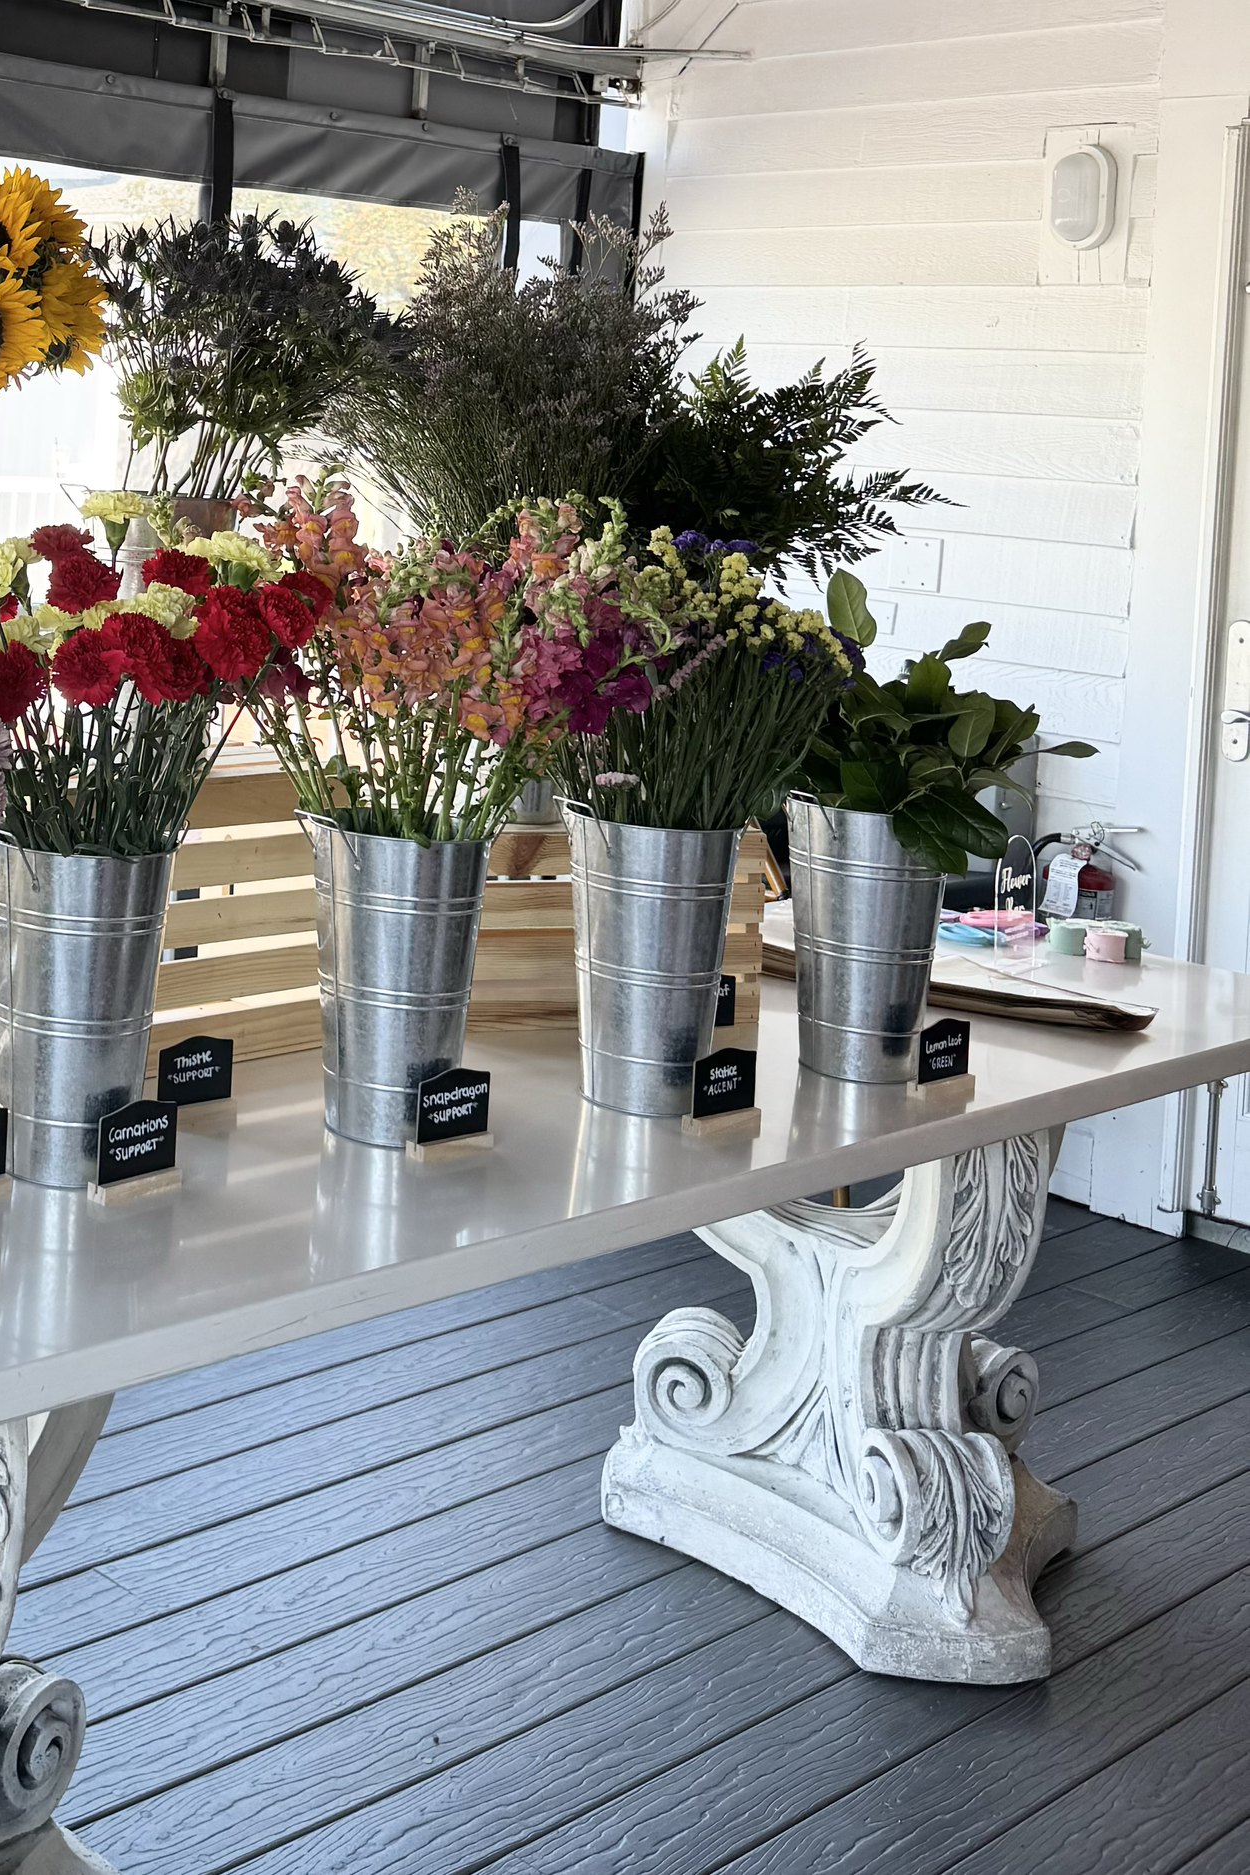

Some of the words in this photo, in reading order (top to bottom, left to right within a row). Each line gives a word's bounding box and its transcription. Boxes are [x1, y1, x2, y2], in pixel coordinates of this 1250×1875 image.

[925, 1040, 947, 1054] Lemon
[947, 1033, 962, 1047] Leaf
[174, 1050, 213, 1070] Thistle
[710, 1064, 737, 1081] Statice
[423, 1083, 488, 1108] Snapdragon
[108, 1114, 169, 1144] Carnations
